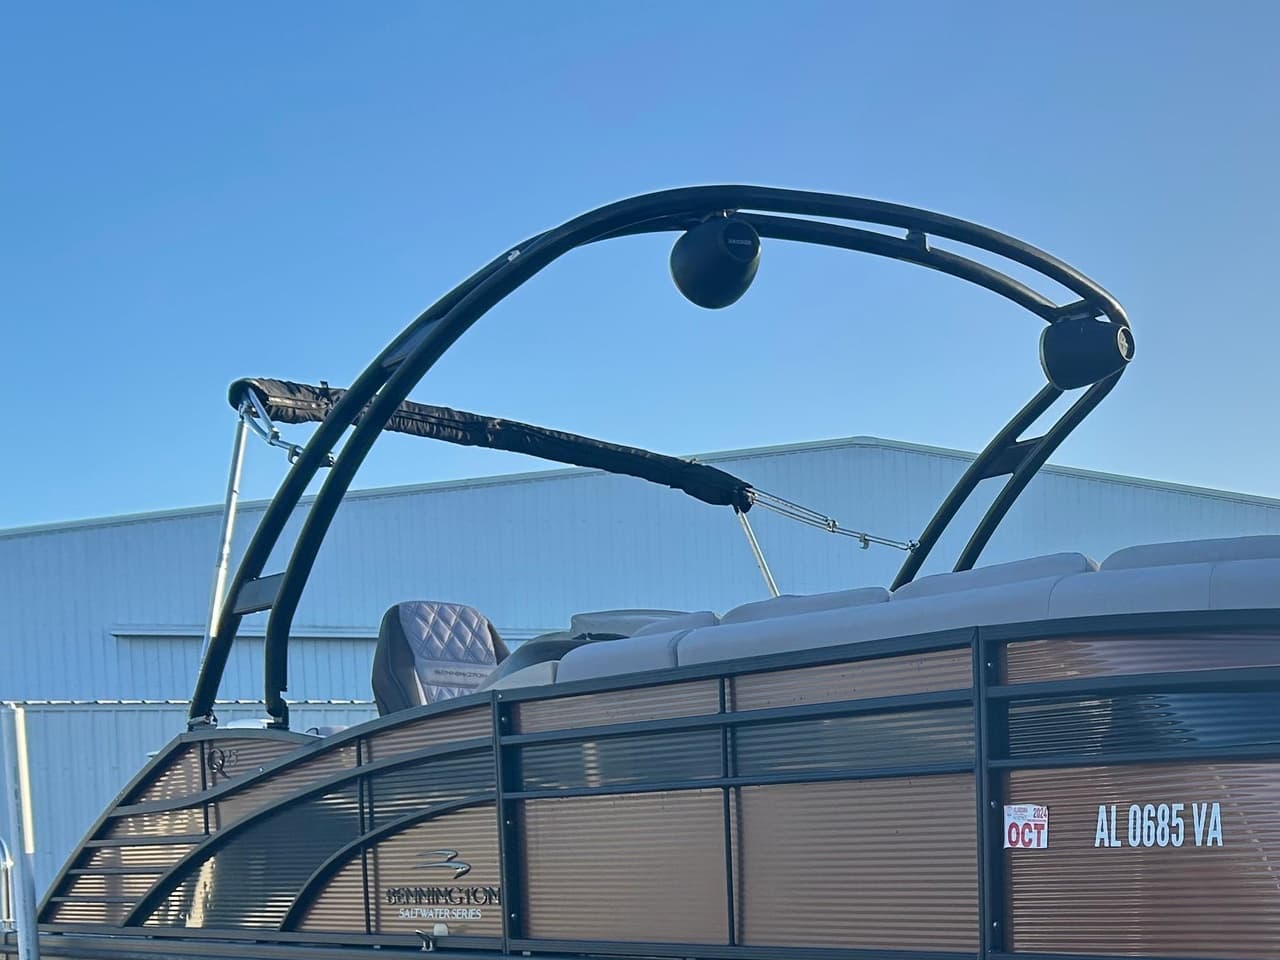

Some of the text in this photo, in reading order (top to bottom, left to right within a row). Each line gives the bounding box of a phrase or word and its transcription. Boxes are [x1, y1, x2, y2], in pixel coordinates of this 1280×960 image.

[1008, 821, 1045, 847] OCT
[1094, 802, 1223, 848] AL 0685 VA
[387, 887, 500, 905] BENNINGTON
[399, 908, 482, 919] SALTWATER SERIES
